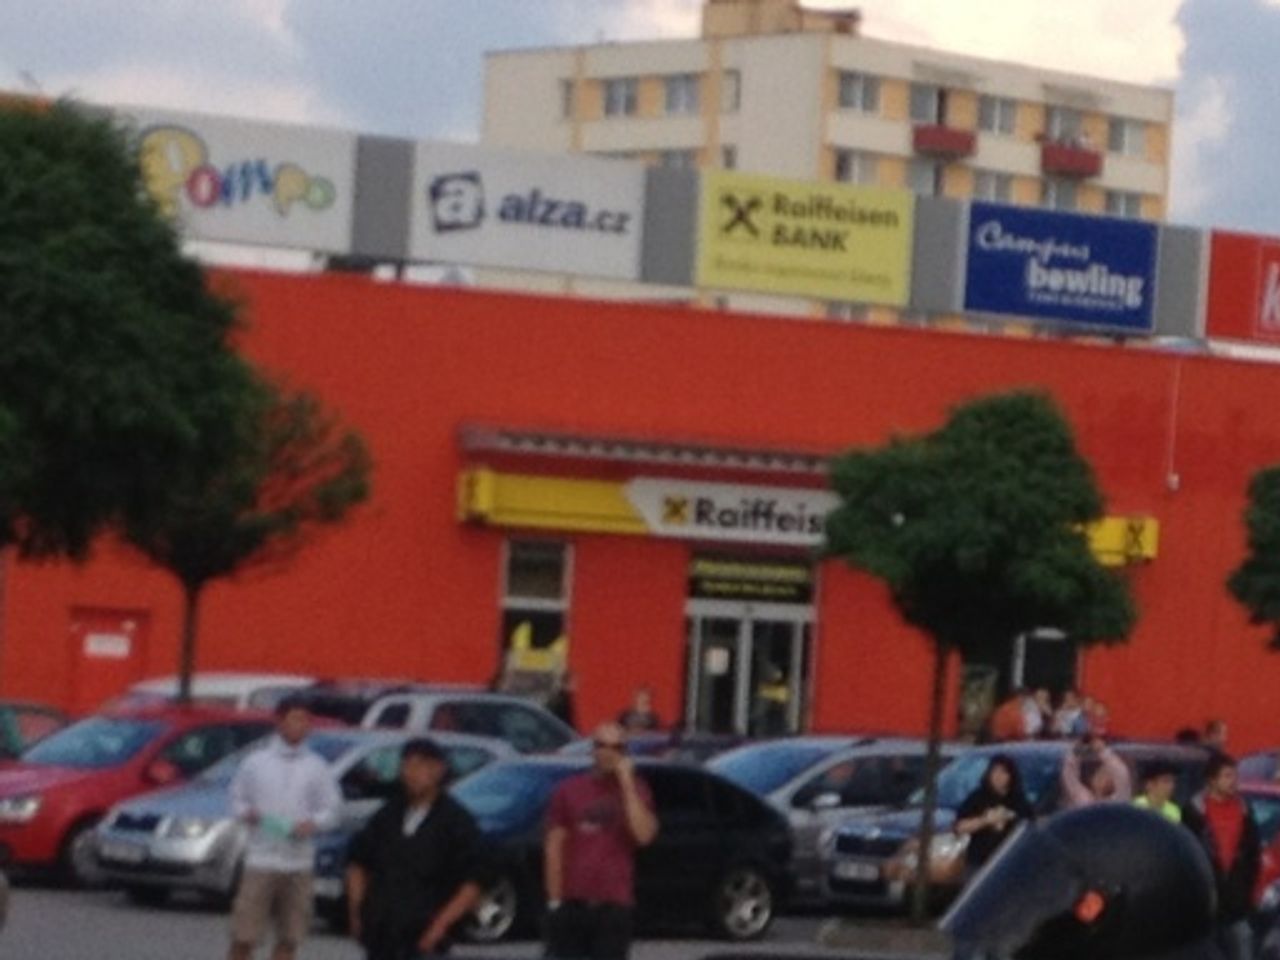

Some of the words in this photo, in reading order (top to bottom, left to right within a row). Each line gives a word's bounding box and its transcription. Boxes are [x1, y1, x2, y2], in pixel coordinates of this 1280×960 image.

[497, 186, 633, 235] alza.cz
[772, 192, 898, 228] Raiffeisen
[771, 223, 848, 252] BANK
[1028, 256, 1144, 309] bowling
